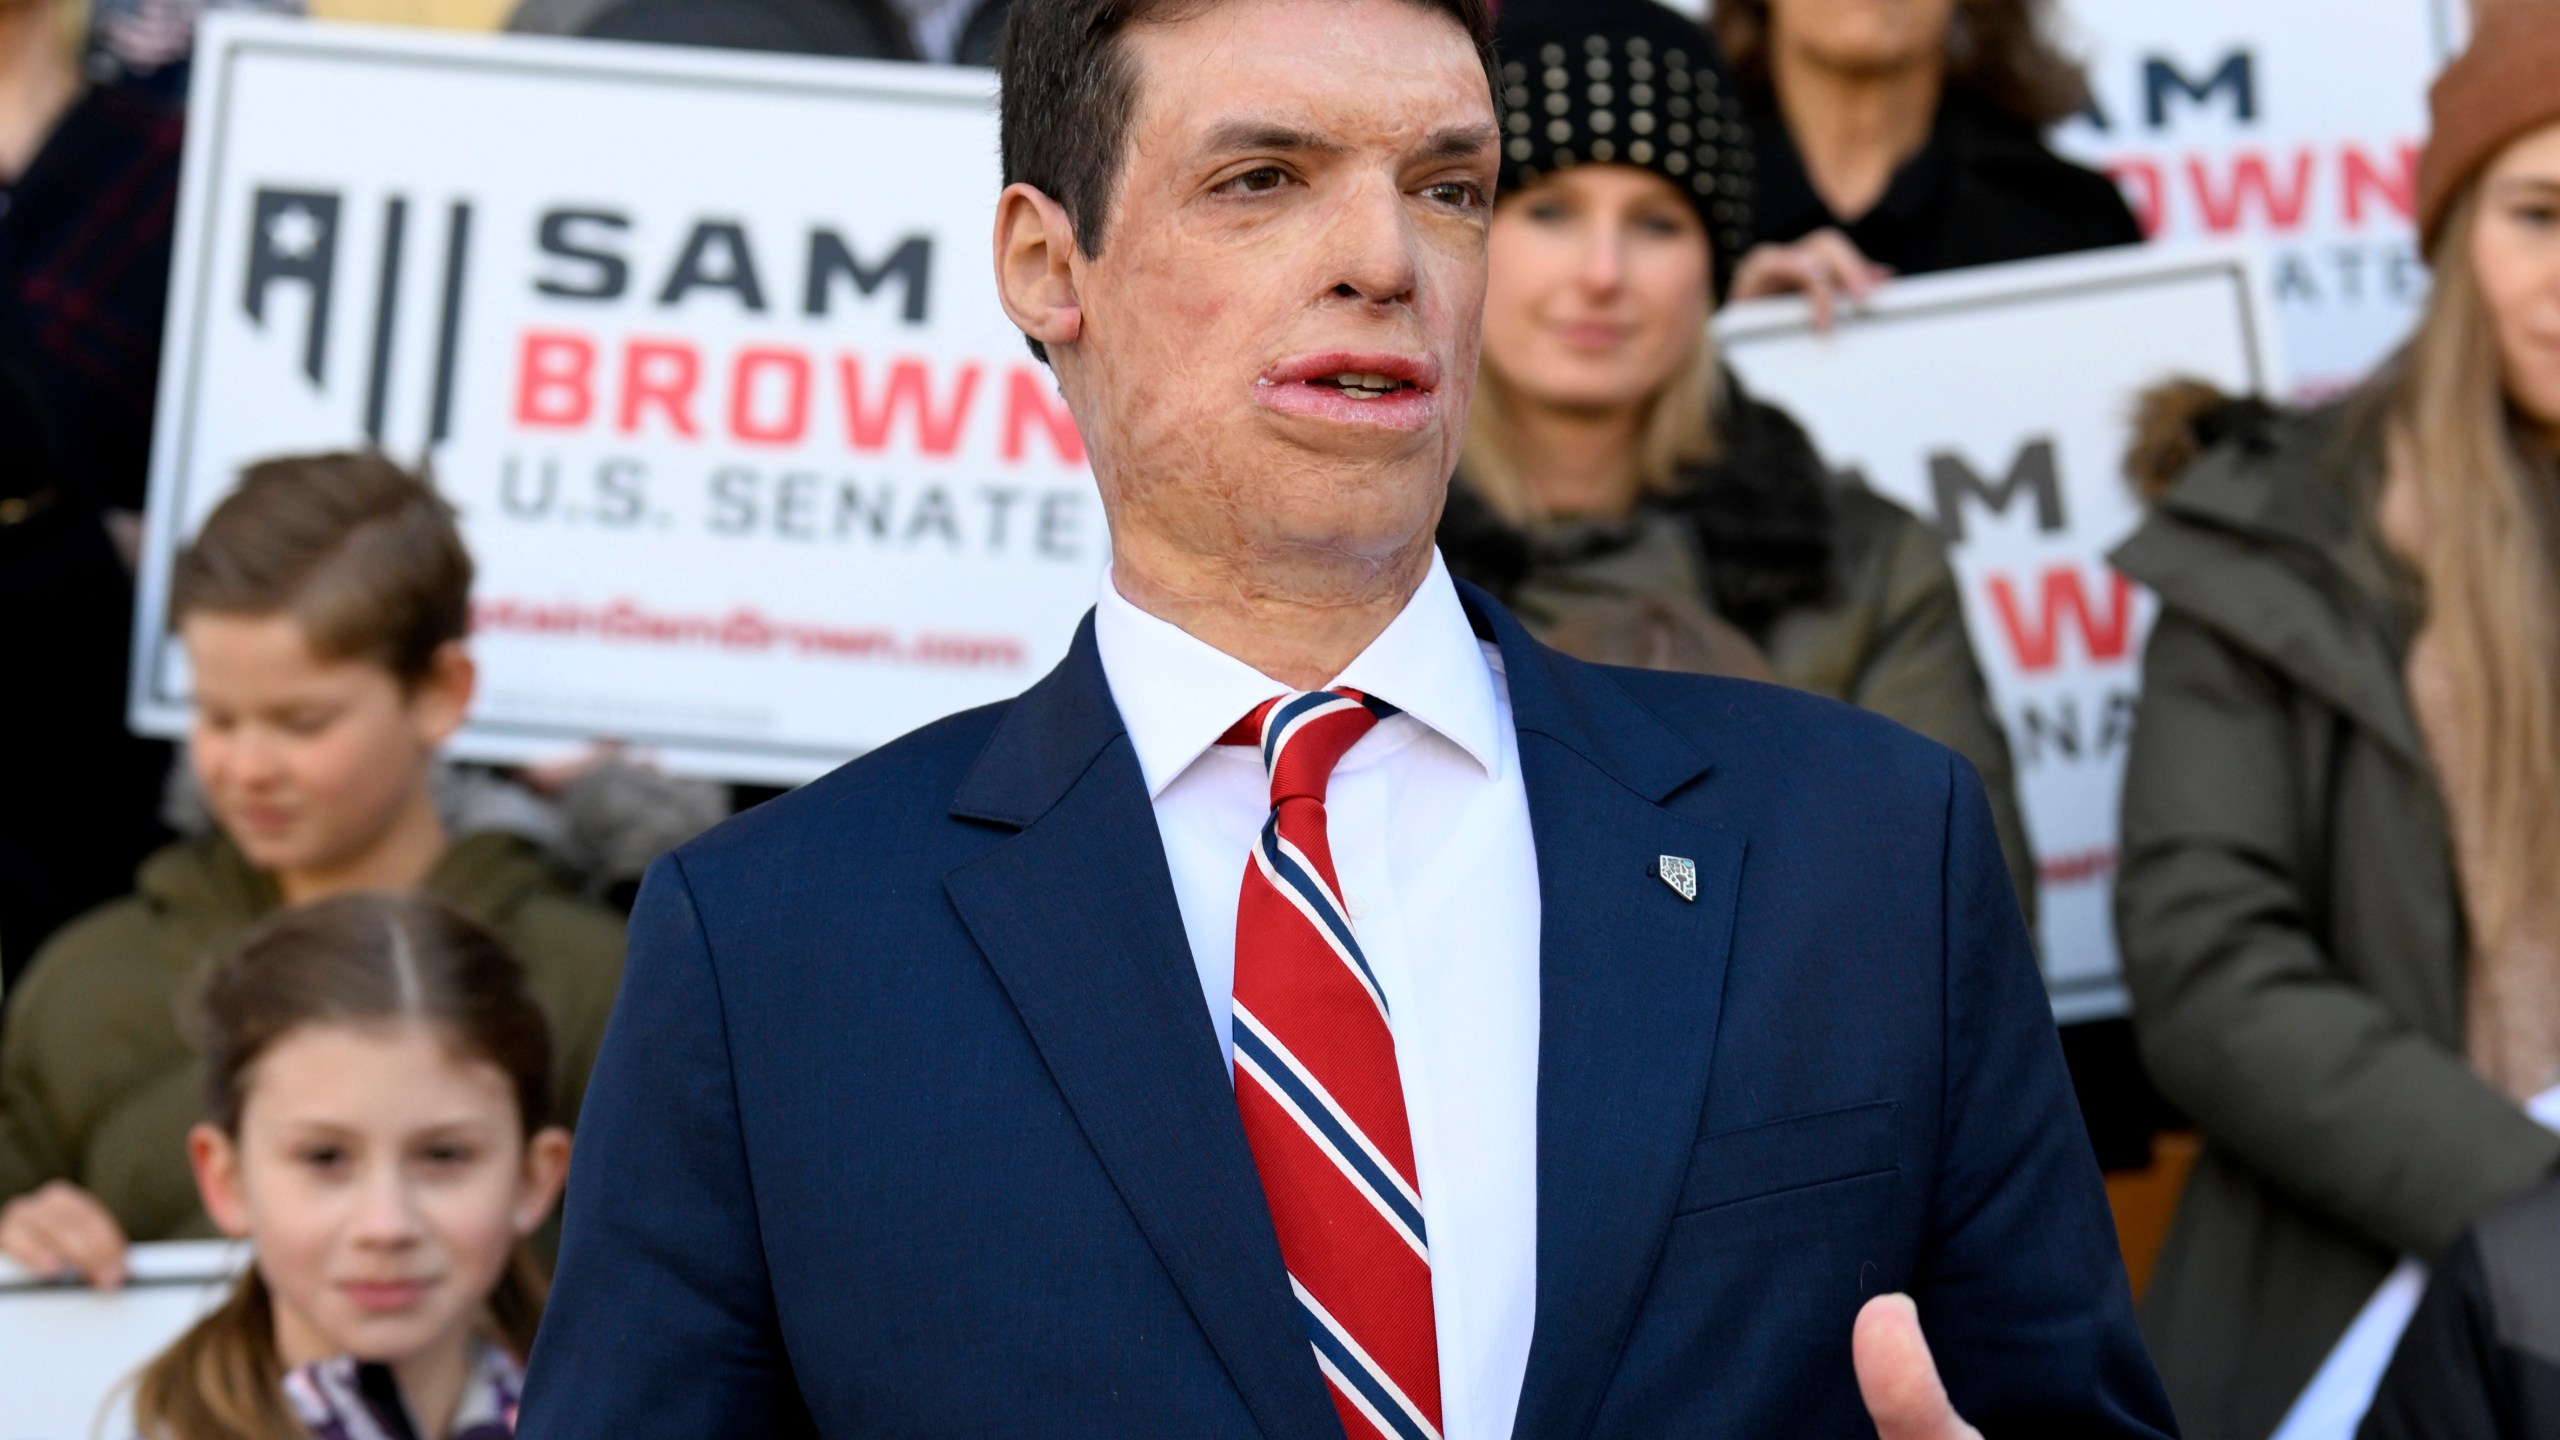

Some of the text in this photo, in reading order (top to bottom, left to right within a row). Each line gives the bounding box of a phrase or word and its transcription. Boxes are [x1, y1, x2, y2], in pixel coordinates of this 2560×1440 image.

[534, 204, 936, 325] SAM
[515, 330, 1089, 465] BROWN
[502, 457, 1083, 560] U.S. SENATE
